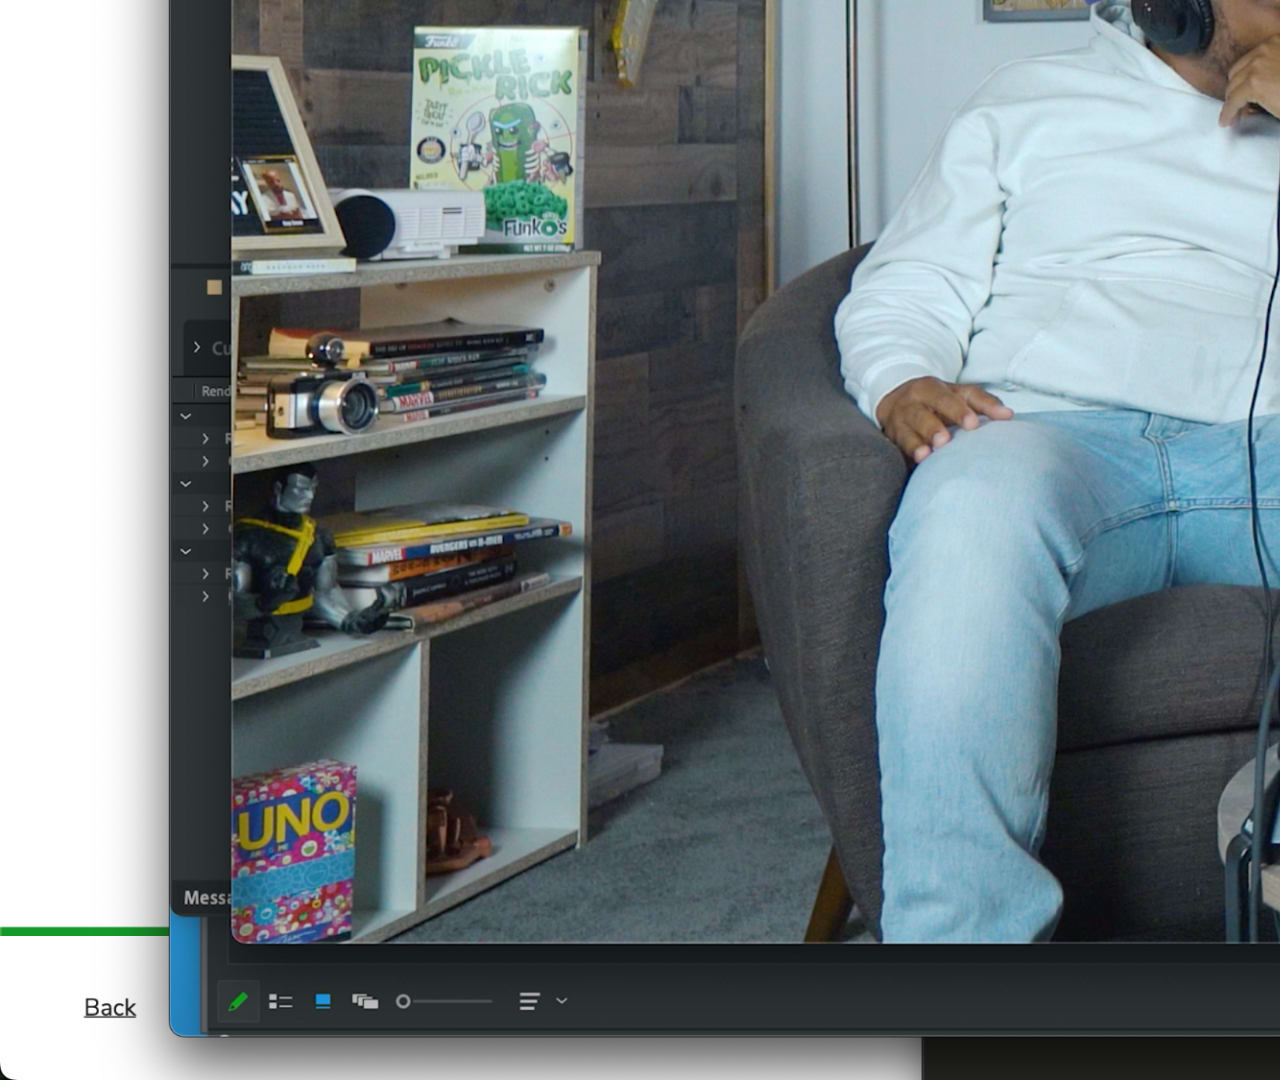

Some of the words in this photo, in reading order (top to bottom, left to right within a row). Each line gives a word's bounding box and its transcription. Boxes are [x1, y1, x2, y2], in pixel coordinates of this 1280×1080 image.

[418, 48, 531, 84] PICKLE
[495, 69, 573, 101] RICK
[371, 547, 405, 564] MARVEL
[239, 790, 350, 851] UNO
[84, 998, 136, 1018] Back
